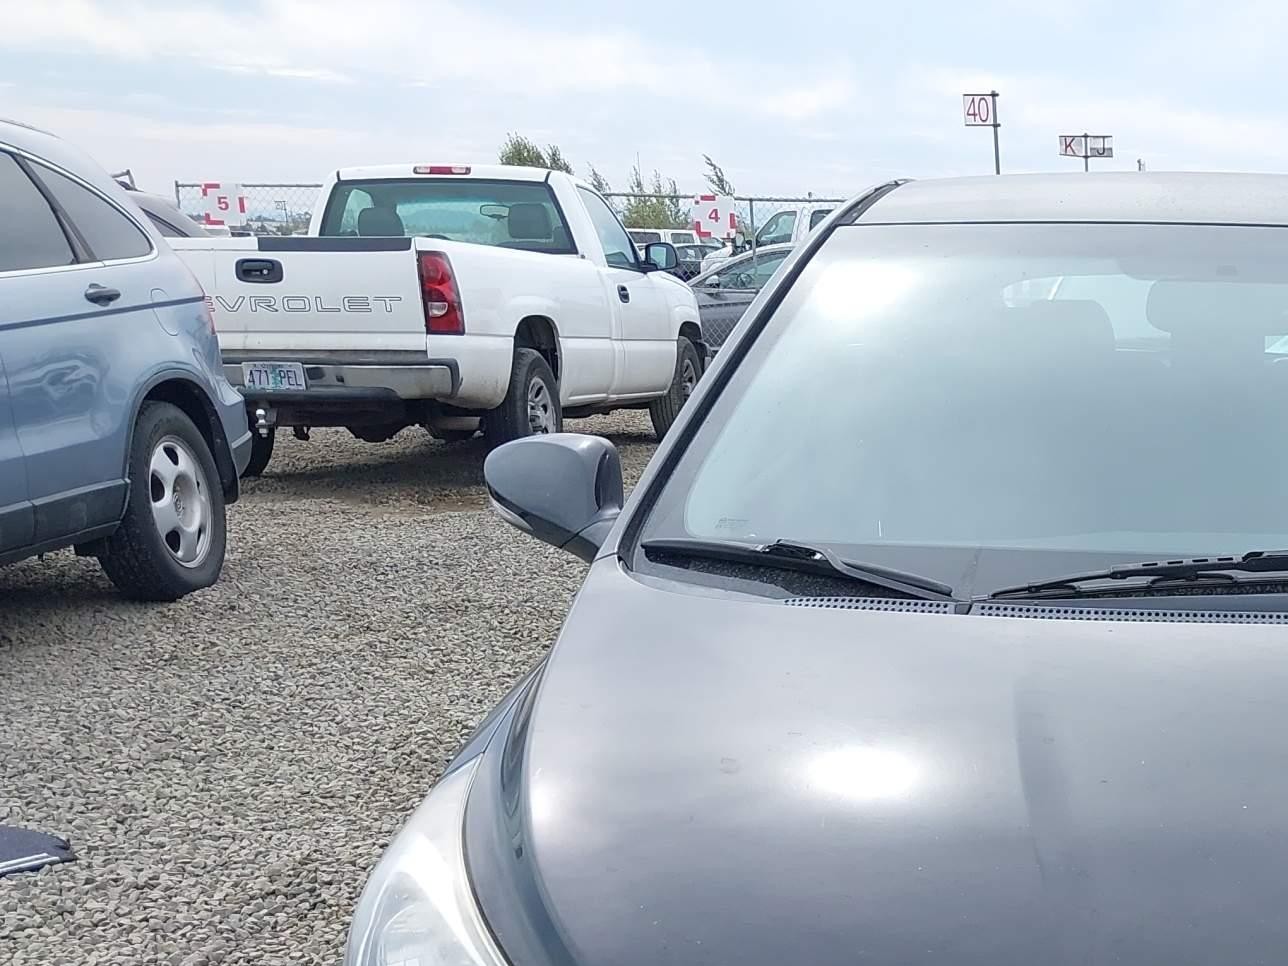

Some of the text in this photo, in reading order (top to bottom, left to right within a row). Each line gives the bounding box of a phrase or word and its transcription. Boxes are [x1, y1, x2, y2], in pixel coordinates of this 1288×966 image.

[966, 97, 989, 123] 40
[1064, 137, 1076, 154] K
[1096, 136, 1106, 155] J
[217, 196, 229, 211] 5
[708, 208, 720, 223] 4
[278, 369, 303, 387] PEL
